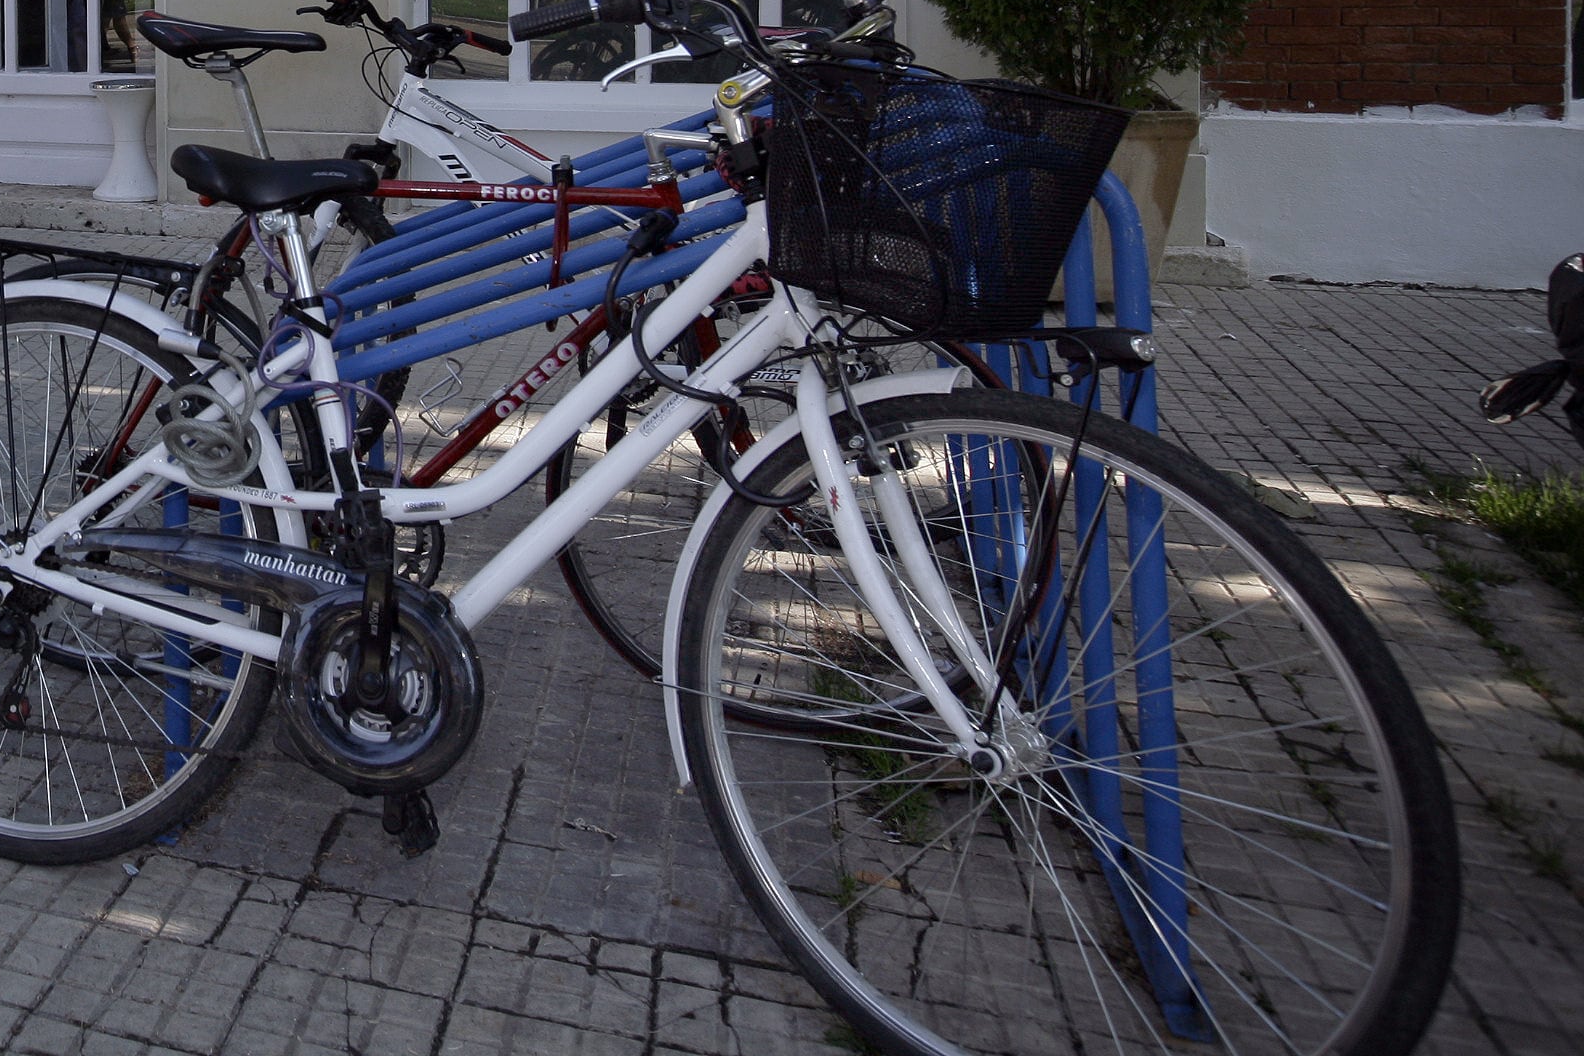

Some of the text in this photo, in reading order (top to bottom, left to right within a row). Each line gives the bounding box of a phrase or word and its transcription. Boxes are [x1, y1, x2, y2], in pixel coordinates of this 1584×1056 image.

[445, 111, 508, 149] OPEN
[495, 342, 579, 419] OTERO
[243, 549, 347, 586] manhattan
